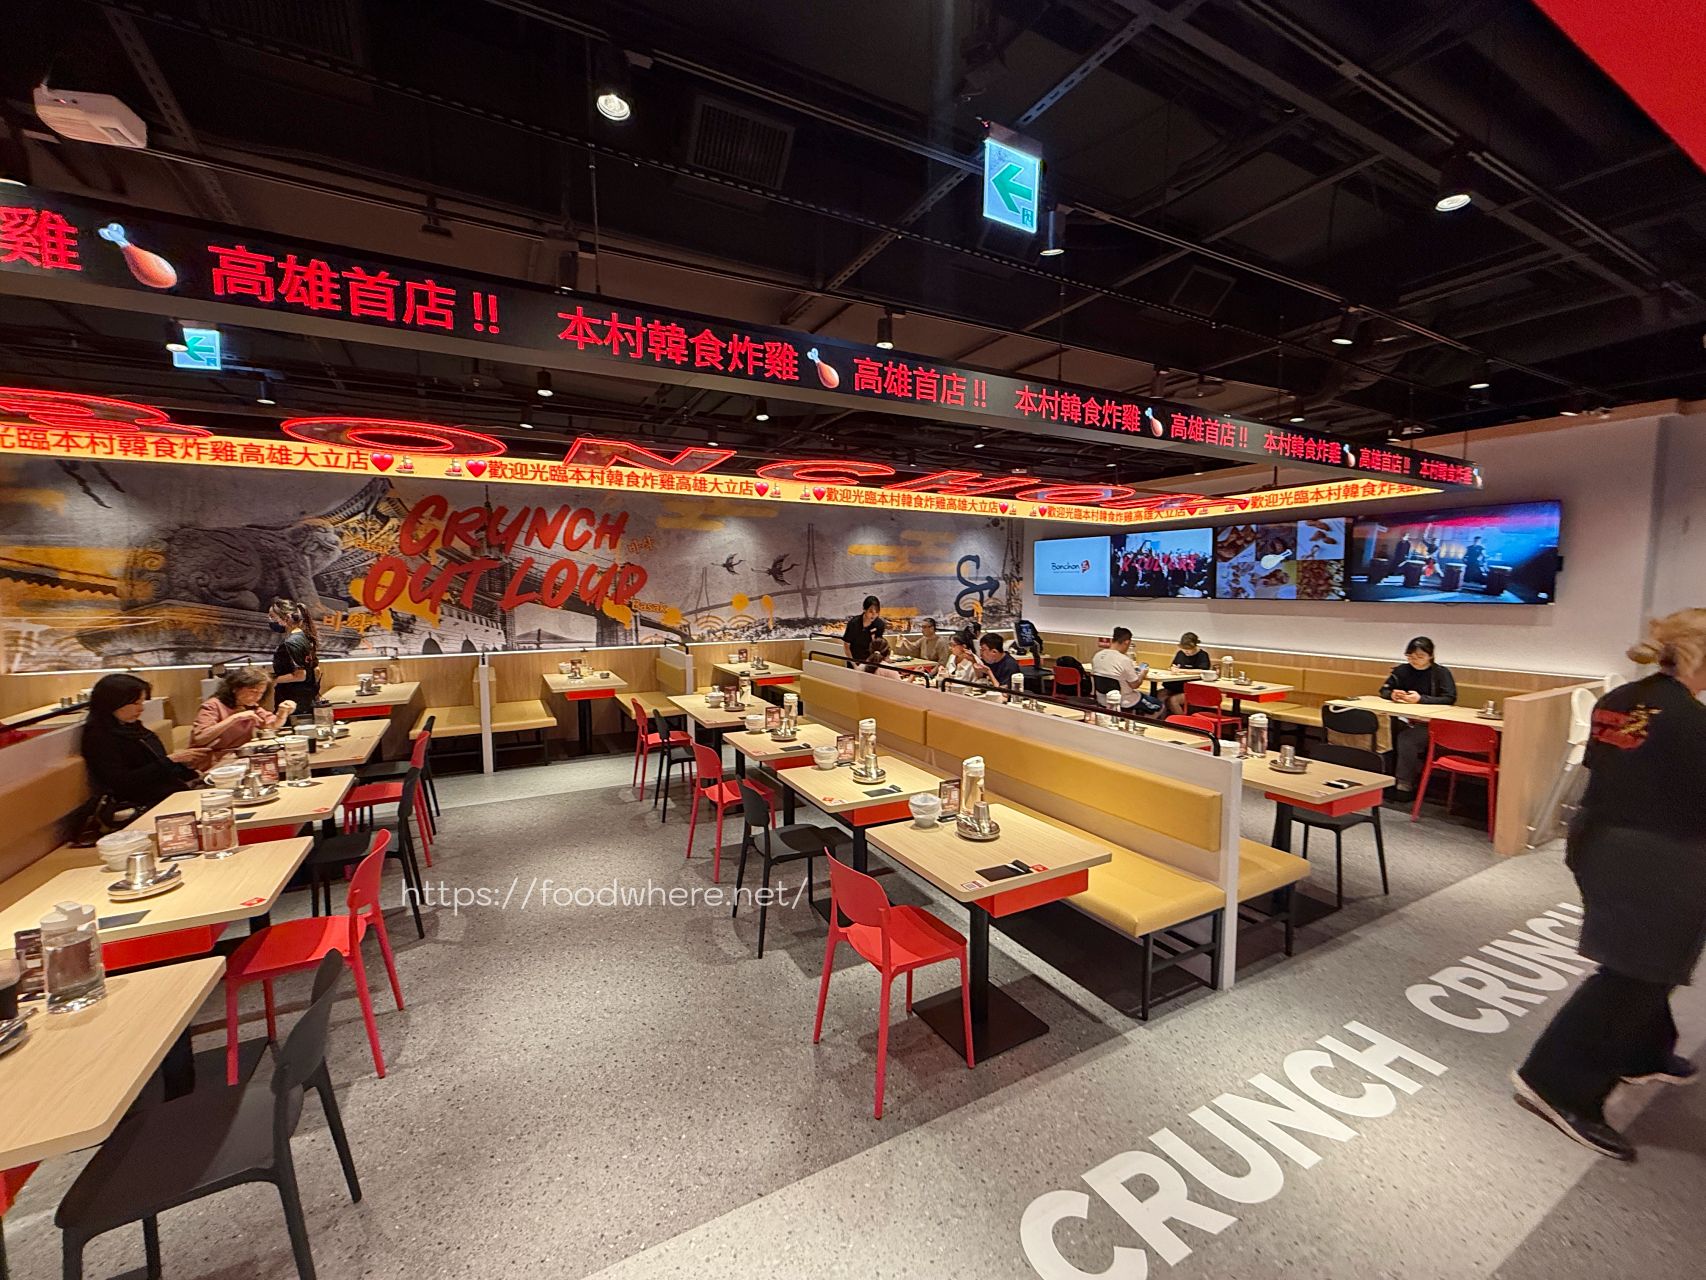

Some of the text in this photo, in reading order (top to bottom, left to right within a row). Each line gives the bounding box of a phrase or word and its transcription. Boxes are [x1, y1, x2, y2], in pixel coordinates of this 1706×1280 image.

[557, 306, 799, 381] 本村韓食炸雞
[1015, 385, 1140, 433] 本村韓食炸雞
[488, 460, 753, 497] 歡迎光臨本村韓食炸雞高雄大立店
[399, 494, 629, 556] CRUNCH
[362, 556, 647, 614] OUT LOUD
[1019, 1020, 1449, 1280] CRUNCH
